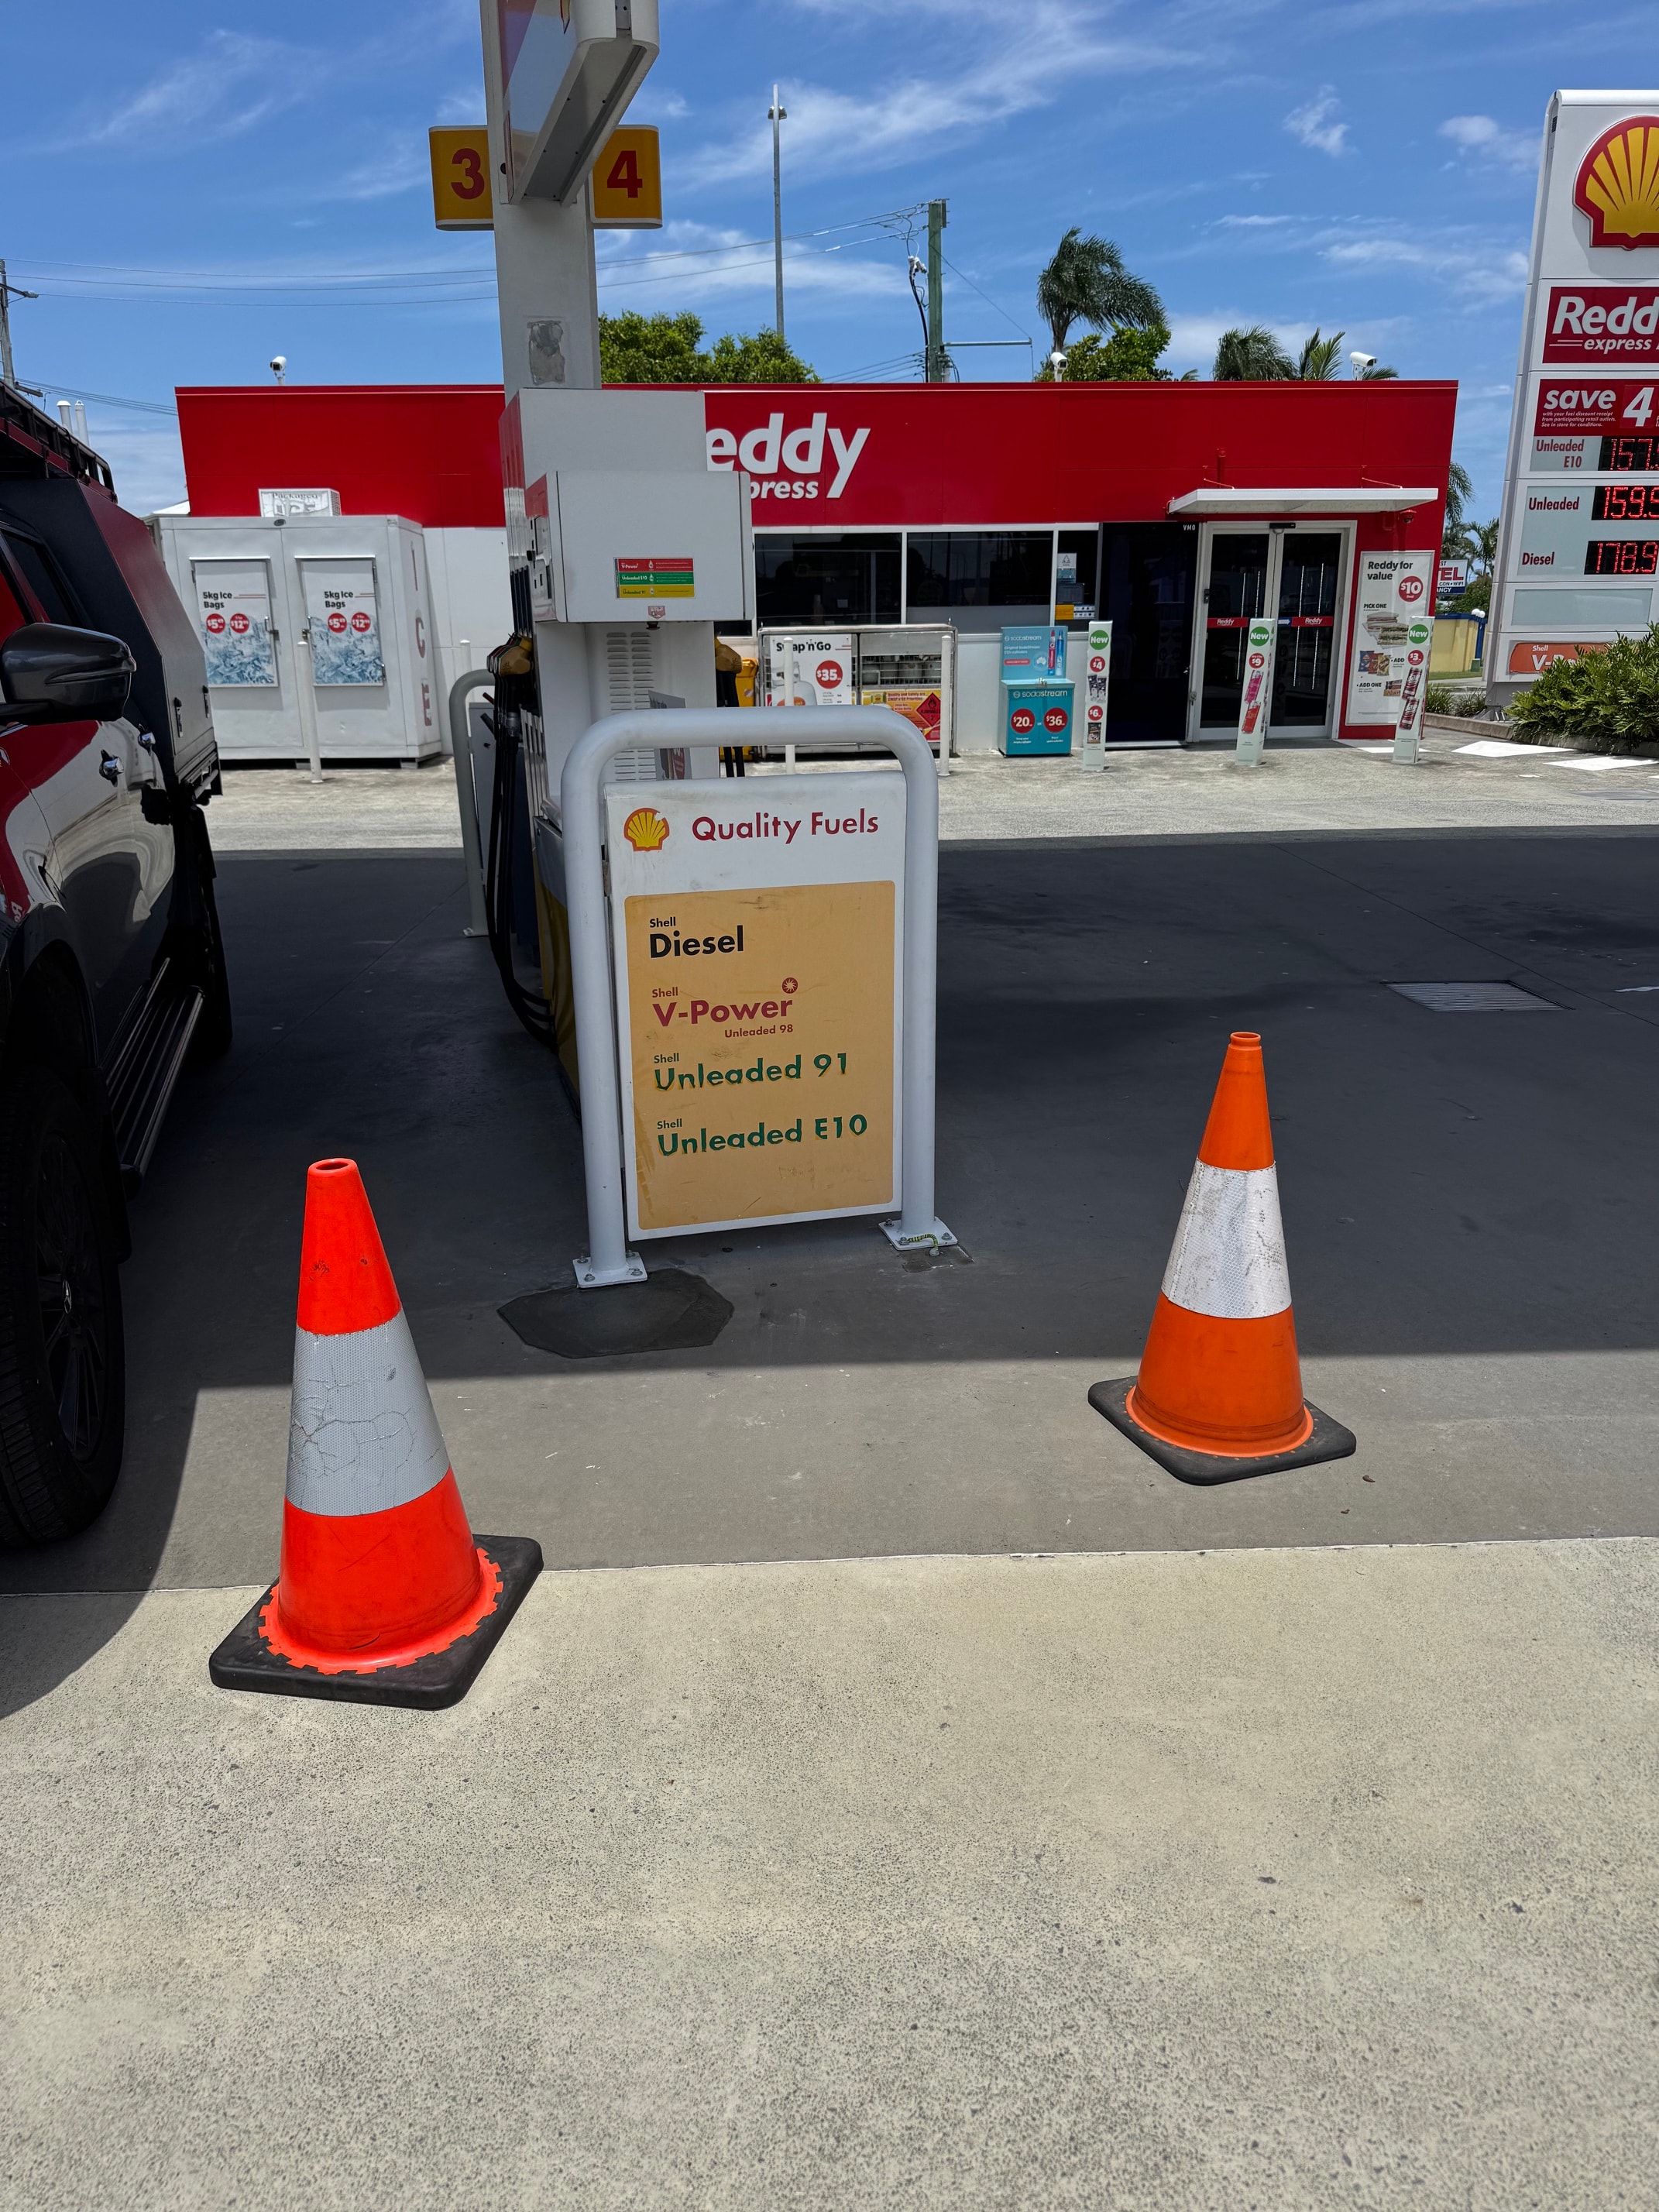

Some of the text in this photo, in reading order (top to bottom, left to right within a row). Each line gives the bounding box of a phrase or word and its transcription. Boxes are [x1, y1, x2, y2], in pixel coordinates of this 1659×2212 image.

[451, 148, 485, 200] 3
[606, 150, 643, 198] 4
[1552, 296, 1659, 335] Redd
[1584, 339, 1652, 354] express
[1544, 390, 1616, 409] save
[1623, 386, 1654, 427] 4
[706, 413, 871, 498] eddy
[1536, 438, 1659, 471] Unleaded 157.
[1564, 455, 1582, 468] E10
[750, 481, 819, 499] ress
[1528, 496, 1580, 510] Unleaded
[1522, 542, 1658, 573] Diesel 178.9
[1368, 561, 1413, 572] Reddy for
[1367, 572, 1393, 580] value
[1438, 567, 1464, 581] EL
[1400, 582, 1422, 594] $10
[202, 591, 218, 600] 5kg
[325, 591, 340, 600] 5kg
[204, 601, 225, 610] Bags
[325, 600, 346, 610] Bags
[1022, 689, 1068, 698] sodastream
[1013, 716, 1030, 726] $20
[1046, 715, 1063, 726] $36
[692, 808, 878, 844] Quality Fuels
[649, 916, 676, 928] Shell
[649, 925, 744, 958] Diesel
[652, 986, 678, 998] Shell
[652, 999, 793, 1027] V-Power
[725, 1024, 794, 1038] Unleaded 98
[654, 1053, 679, 1063] Shell
[654, 1053, 847, 1091] Unleaded 91
[657, 1118, 682, 1129] Shell
[657, 1114, 867, 1156] Unleaded E10
